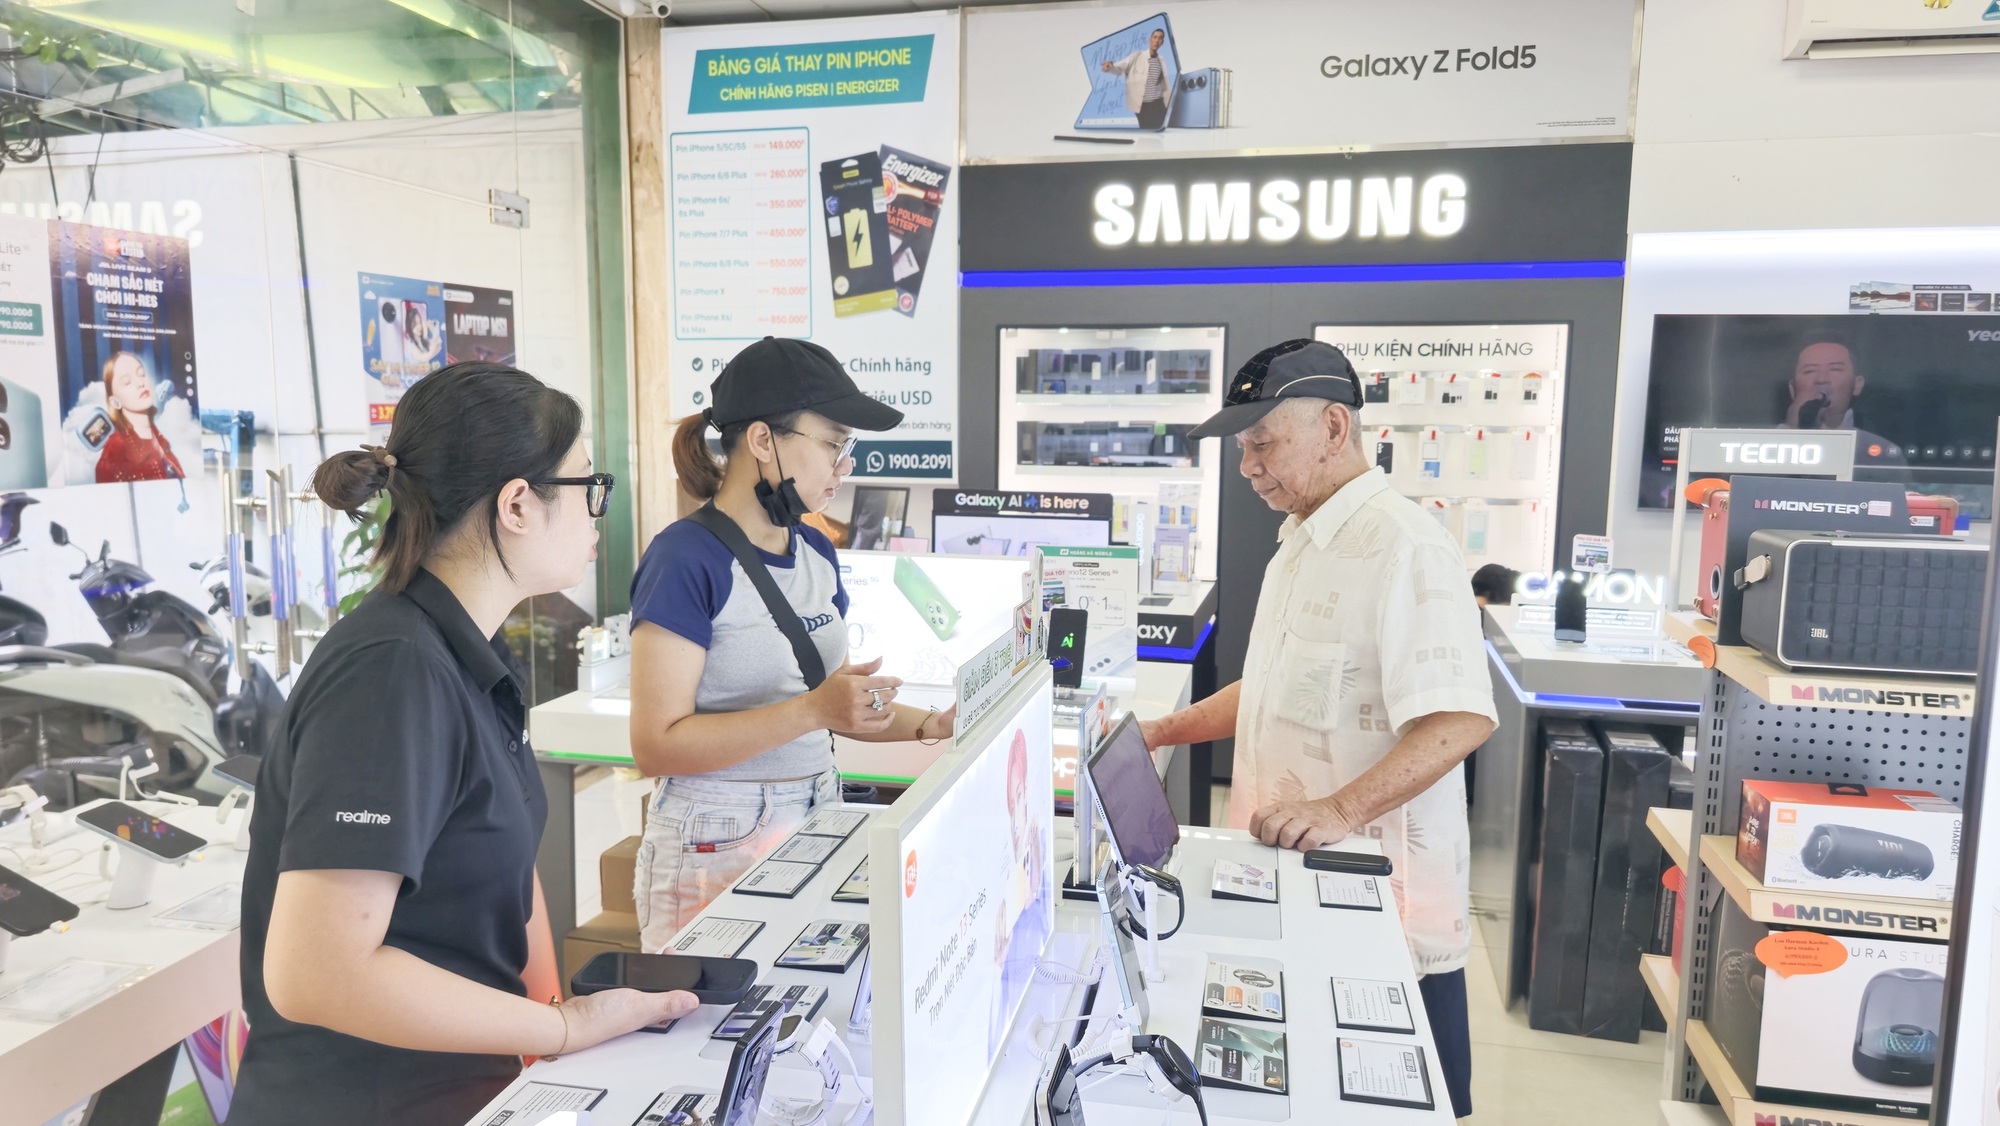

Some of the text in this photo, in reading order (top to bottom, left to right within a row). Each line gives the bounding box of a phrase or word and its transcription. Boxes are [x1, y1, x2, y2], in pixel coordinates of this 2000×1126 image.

[708, 48, 911, 77] BẢNG GIÁ THAY PIN IPHONE
[1320, 44, 1537, 81] Galaxy Z Fold5
[720, 83, 756, 101] CHÍNH
[758, 82, 793, 99] HÃNG
[796, 83, 829, 97] PISEN
[836, 78, 899, 96] ENERGIZER
[676, 145, 688, 153] Pin
[689, 143, 714, 152] iPhone
[677, 173, 689, 181] Pin
[690, 172, 716, 181] iPhone
[731, 171, 747, 179] Plus
[692, 196, 717, 205] iPhone
[898, 208, 934, 227] POLYMER
[1094, 174, 1467, 246] SAMSUNG
[692, 230, 717, 238] iPhone
[732, 229, 748, 237] Plus
[692, 260, 717, 269] iPhone
[86, 272, 120, 291] CHẠM
[144, 276, 164, 293] NÉT
[123, 292, 158, 308] HI-RES
[693, 288, 718, 296] iPhone
[0, 306, 33, 317] 90.000đ
[0, 320, 33, 331] 90.000đ
[453, 313, 490, 337] LAPTOP
[1374, 339, 1413, 361] KIỆN
[1417, 339, 1473, 357] CHÍNH
[1479, 338, 1533, 356] HÃNG
[850, 358, 891, 373] Chính
[896, 357, 931, 375] hãng
[901, 391, 932, 405] USD
[889, 453, 952, 470] 1900.2091
[1719, 442, 1822, 465] TECNO
[954, 492, 1089, 510] Galaxy AI is here
[1770, 499, 1860, 515] MONSTER
[1094, 549, 1113, 557] MOBILE
[842, 576, 868, 586] eries
[1810, 628, 1828, 639] JBL
[1818, 686, 1961, 709] MONSTER
[335, 809, 391, 825] realme
[1796, 904, 1938, 933] MONSTER
[914, 958, 940, 1014] Redmi
[939, 931, 959, 971] Note
[968, 887, 987, 926] Series
